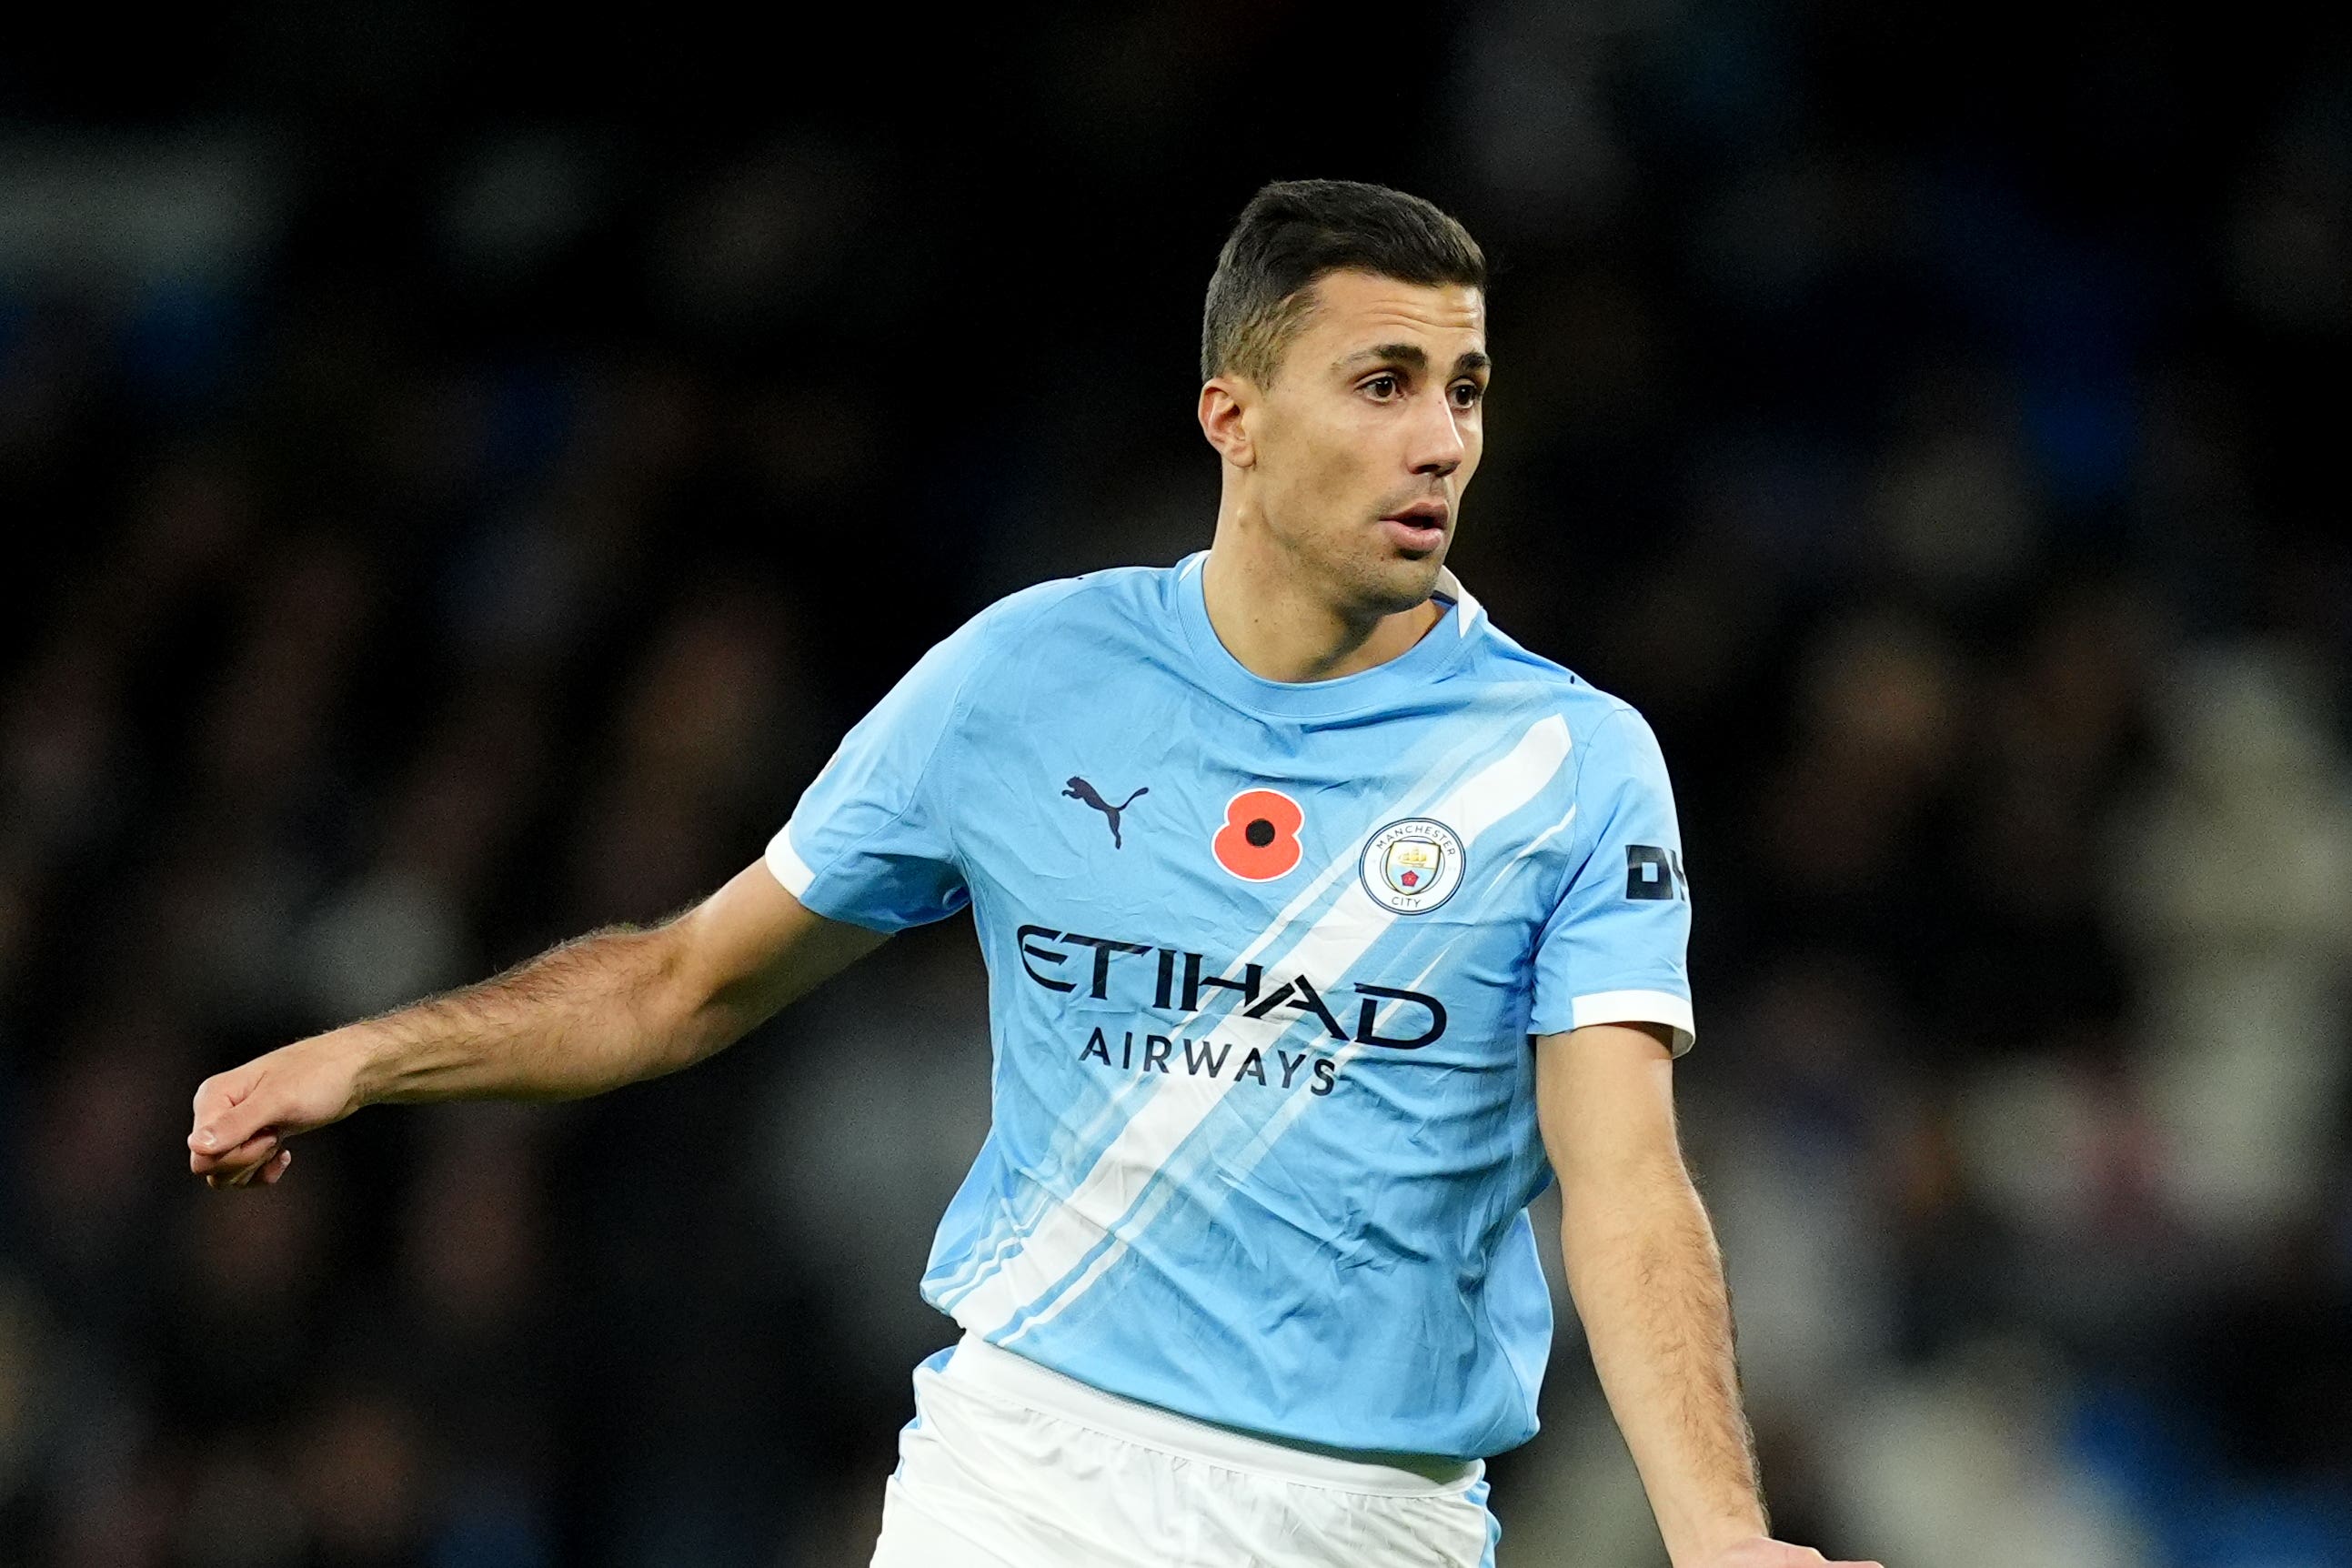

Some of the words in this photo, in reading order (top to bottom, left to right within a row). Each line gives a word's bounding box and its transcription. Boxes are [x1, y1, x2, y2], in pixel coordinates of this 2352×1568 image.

[1376, 825, 1456, 857] MANCHESTER
[1391, 896, 1422, 908] CITY
[1017, 924, 1448, 1050] ETIHAD
[1079, 1026, 1336, 1096] AIRWAYS
